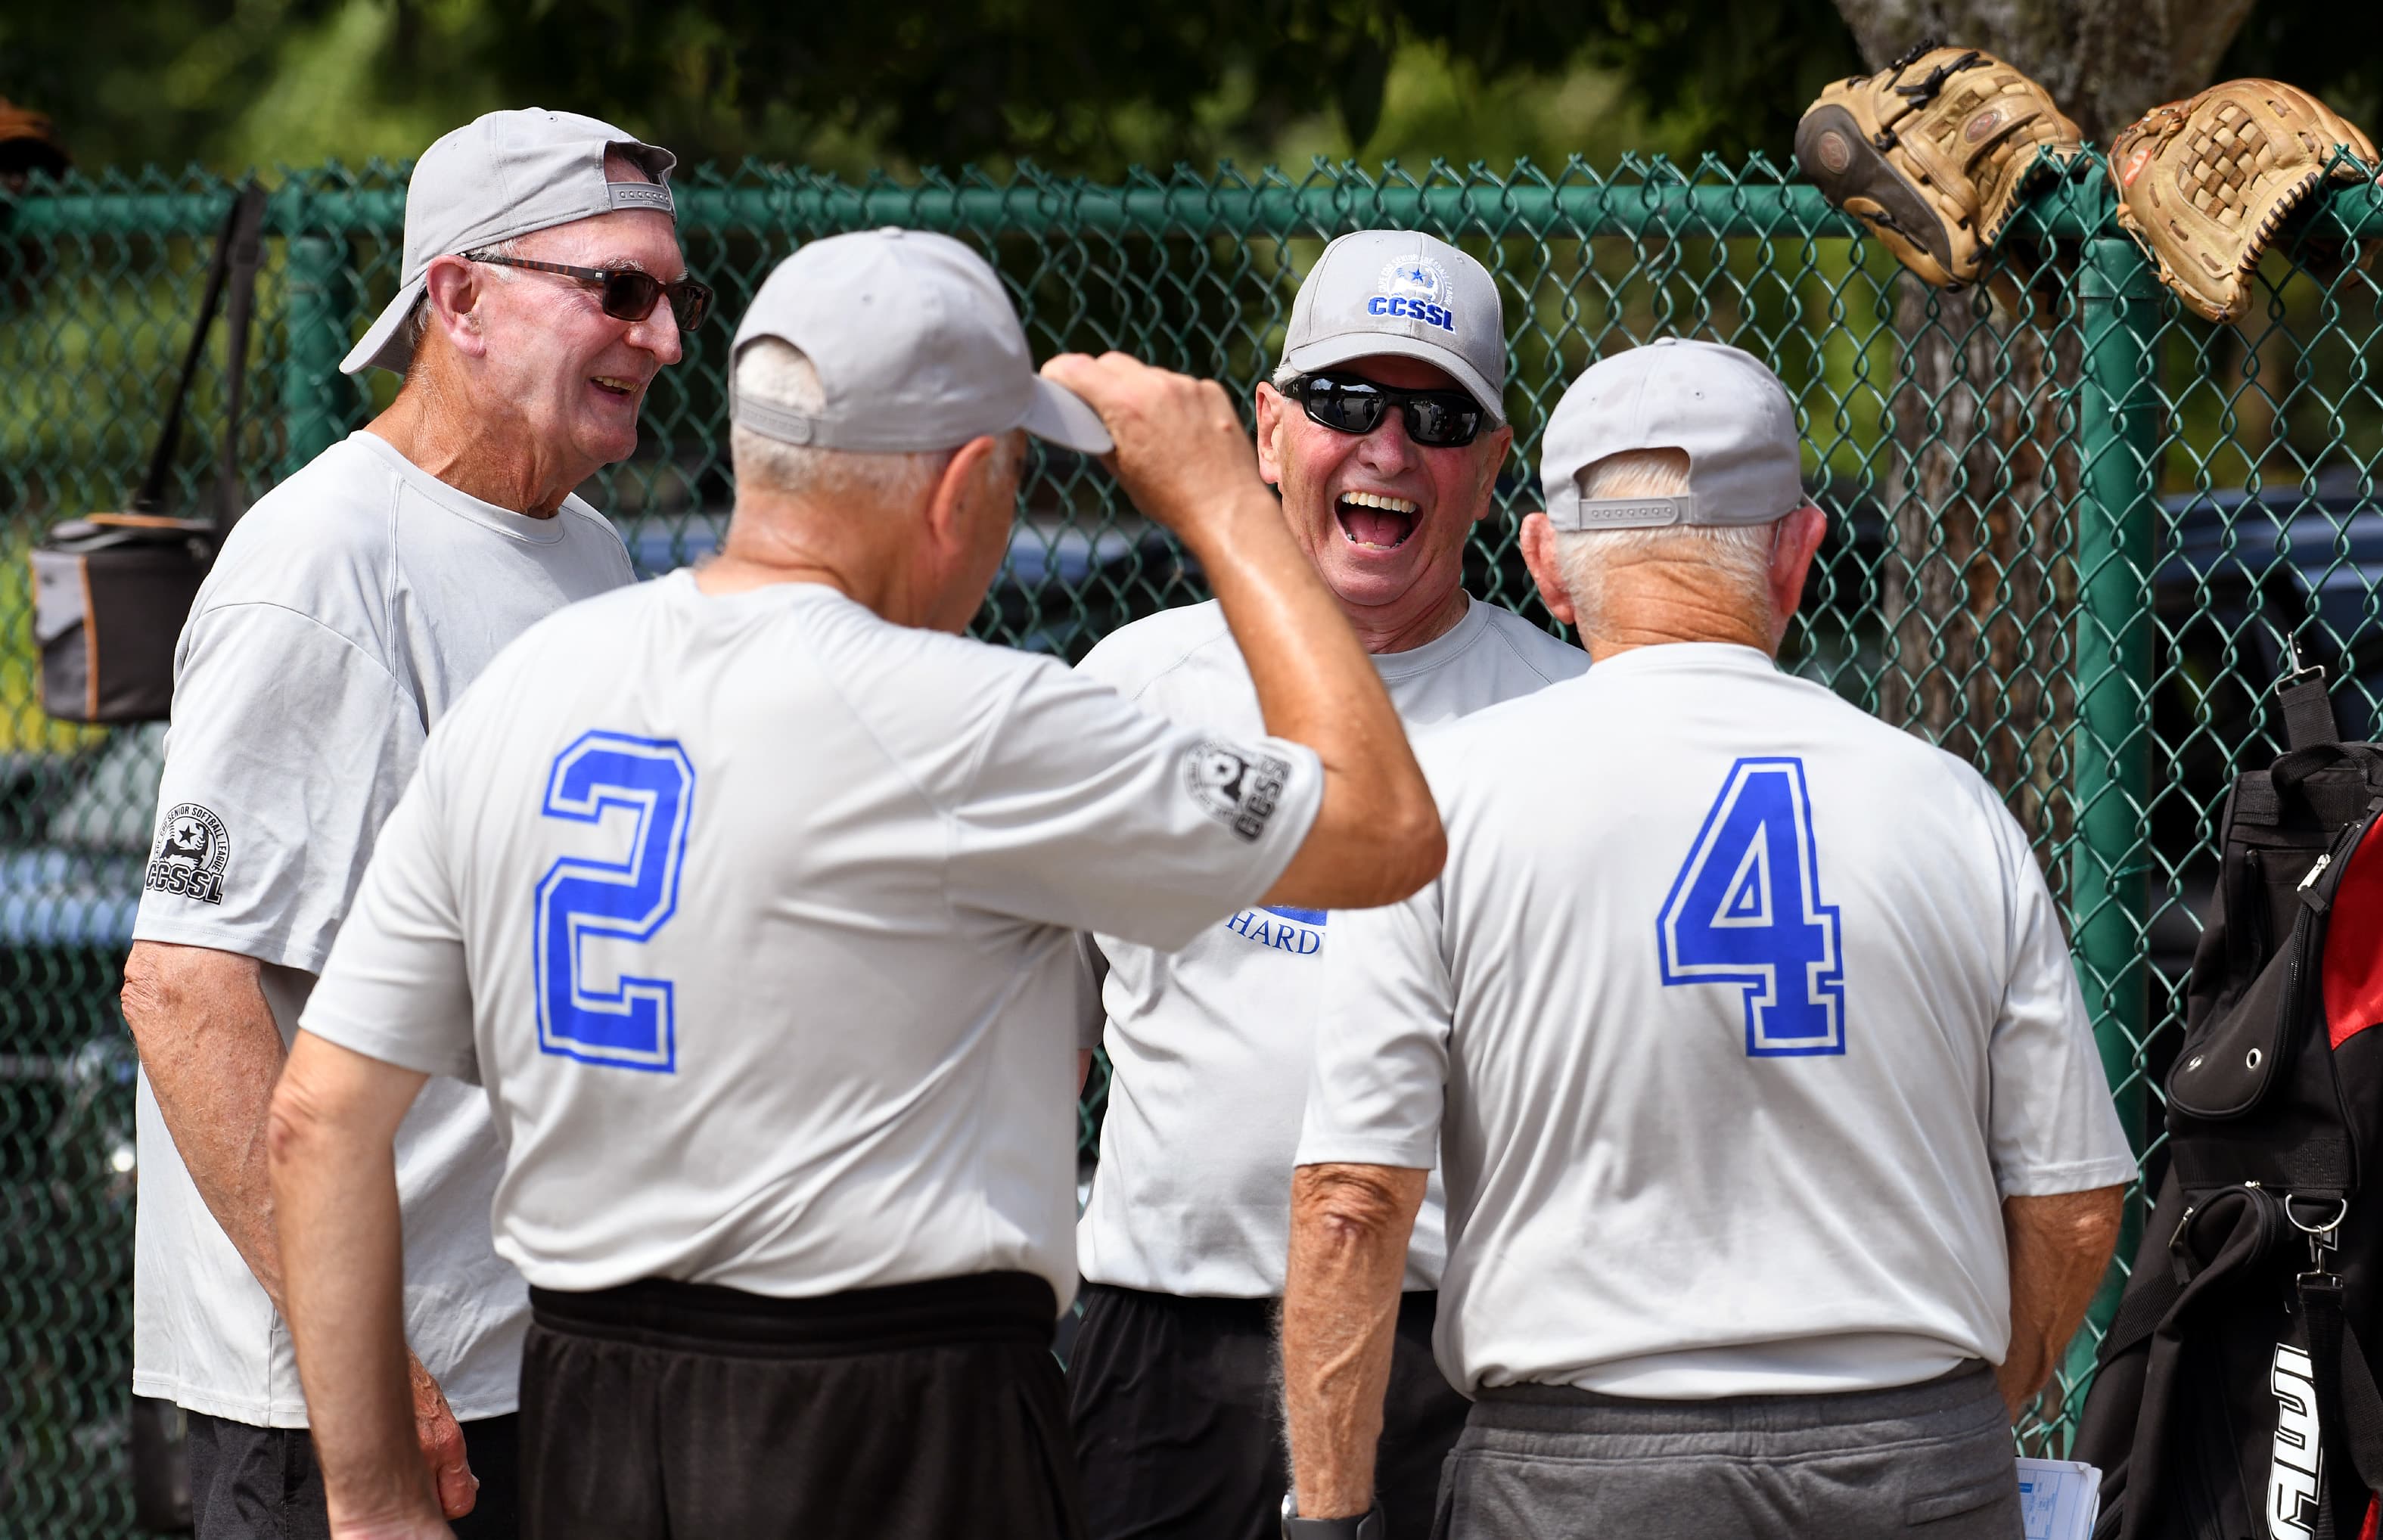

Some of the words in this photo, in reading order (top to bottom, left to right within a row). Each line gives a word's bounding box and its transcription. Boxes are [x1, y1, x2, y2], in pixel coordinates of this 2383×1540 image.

[1367, 296, 1456, 334] CCSSL
[167, 806, 189, 822] SENIOR
[191, 807, 225, 840] SOFTBALL
[211, 840, 227, 872] LEAGUE
[146, 861, 224, 905] CCSSL
[533, 729, 695, 1073] 2
[1656, 757, 1846, 1057] 4
[1226, 909, 1325, 955] HARD
